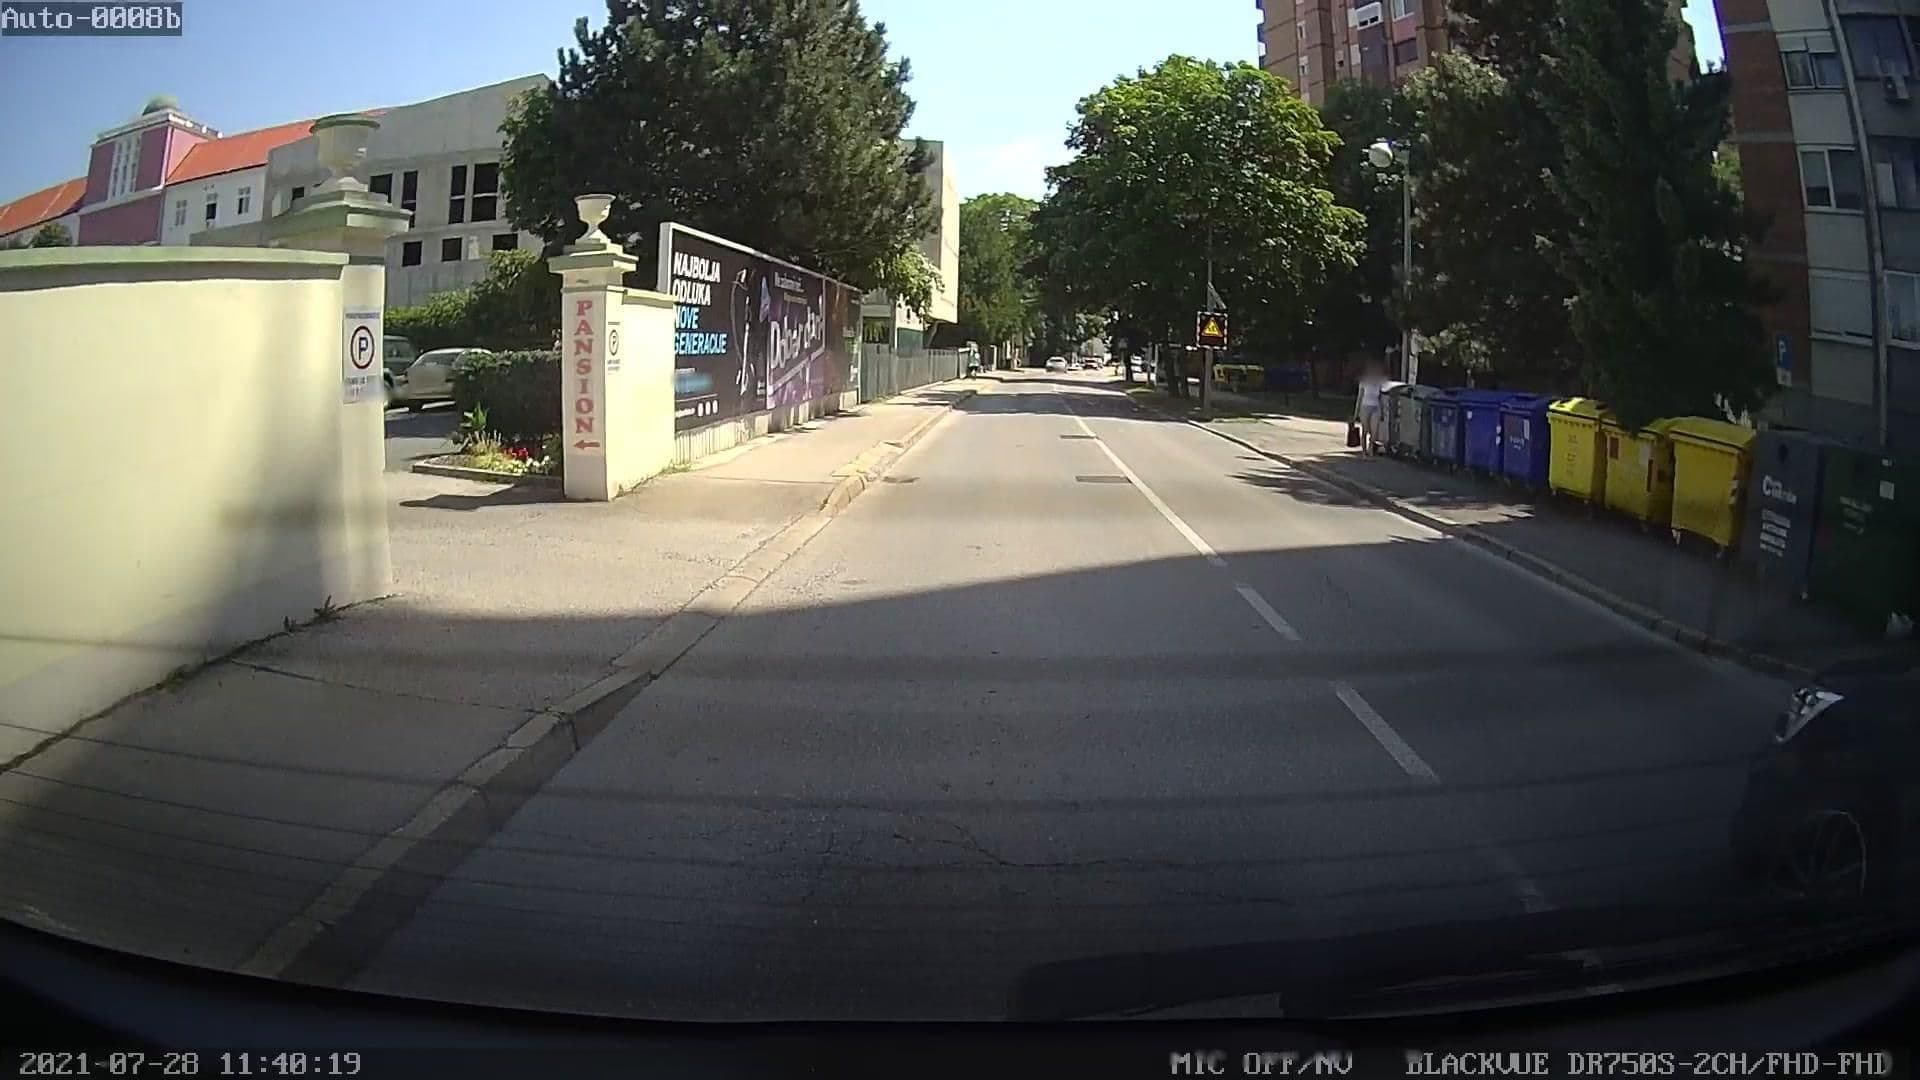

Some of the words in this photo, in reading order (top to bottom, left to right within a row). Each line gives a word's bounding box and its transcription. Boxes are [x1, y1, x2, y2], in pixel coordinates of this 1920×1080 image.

[673, 251, 721, 283] NAJBOLJA
[672, 278, 711, 306] ODLUKA
[674, 305, 700, 329] NOVE
[358, 336, 369, 360] P
[674, 332, 728, 355] GENERACIJE
[574, 300, 594, 433] PANSION
